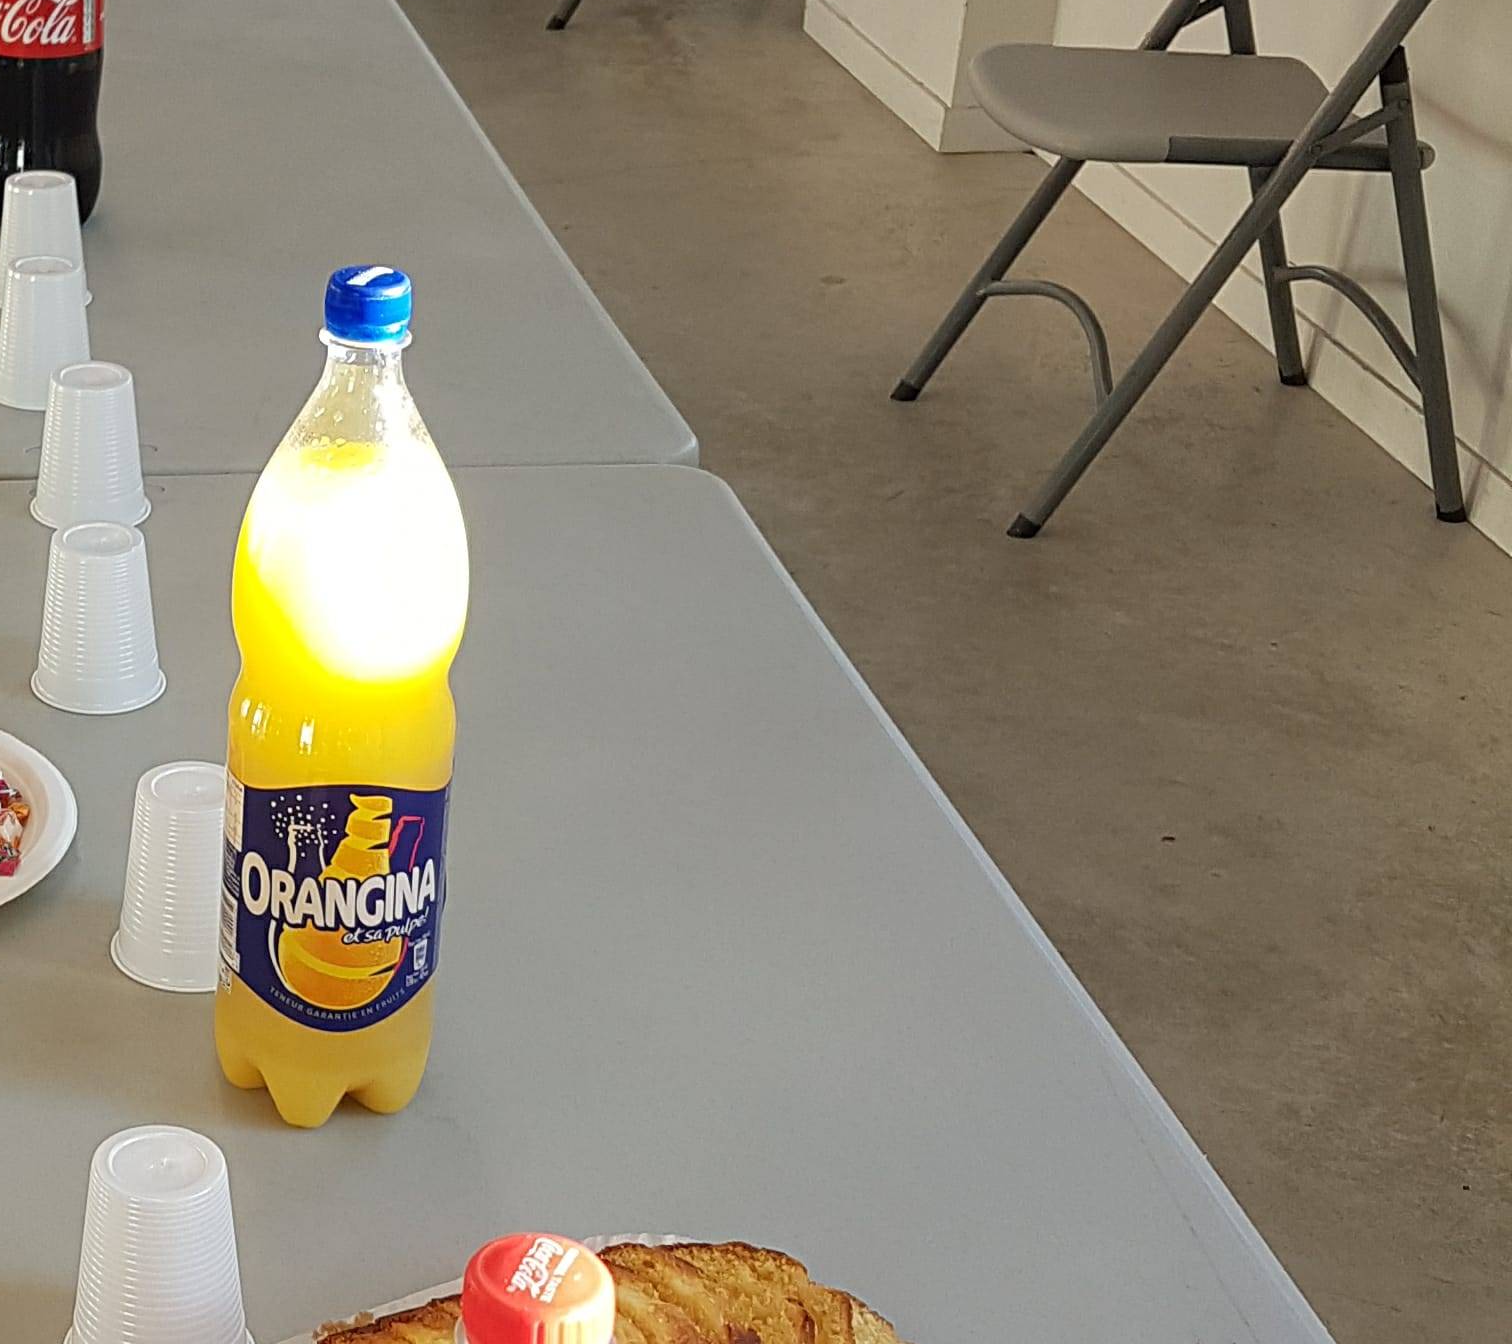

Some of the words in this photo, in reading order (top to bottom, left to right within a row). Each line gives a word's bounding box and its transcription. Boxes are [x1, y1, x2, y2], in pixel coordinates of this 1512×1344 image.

[241, 851, 436, 928] ORANGINA
[343, 927, 365, 943] et
[364, 928, 383, 942] sa
[269, 985, 304, 1011] TENEUR
[307, 1009, 357, 1021] GARANTIE
[361, 1007, 373, 1017] EN
[376, 987, 406, 1011] FRUITS
